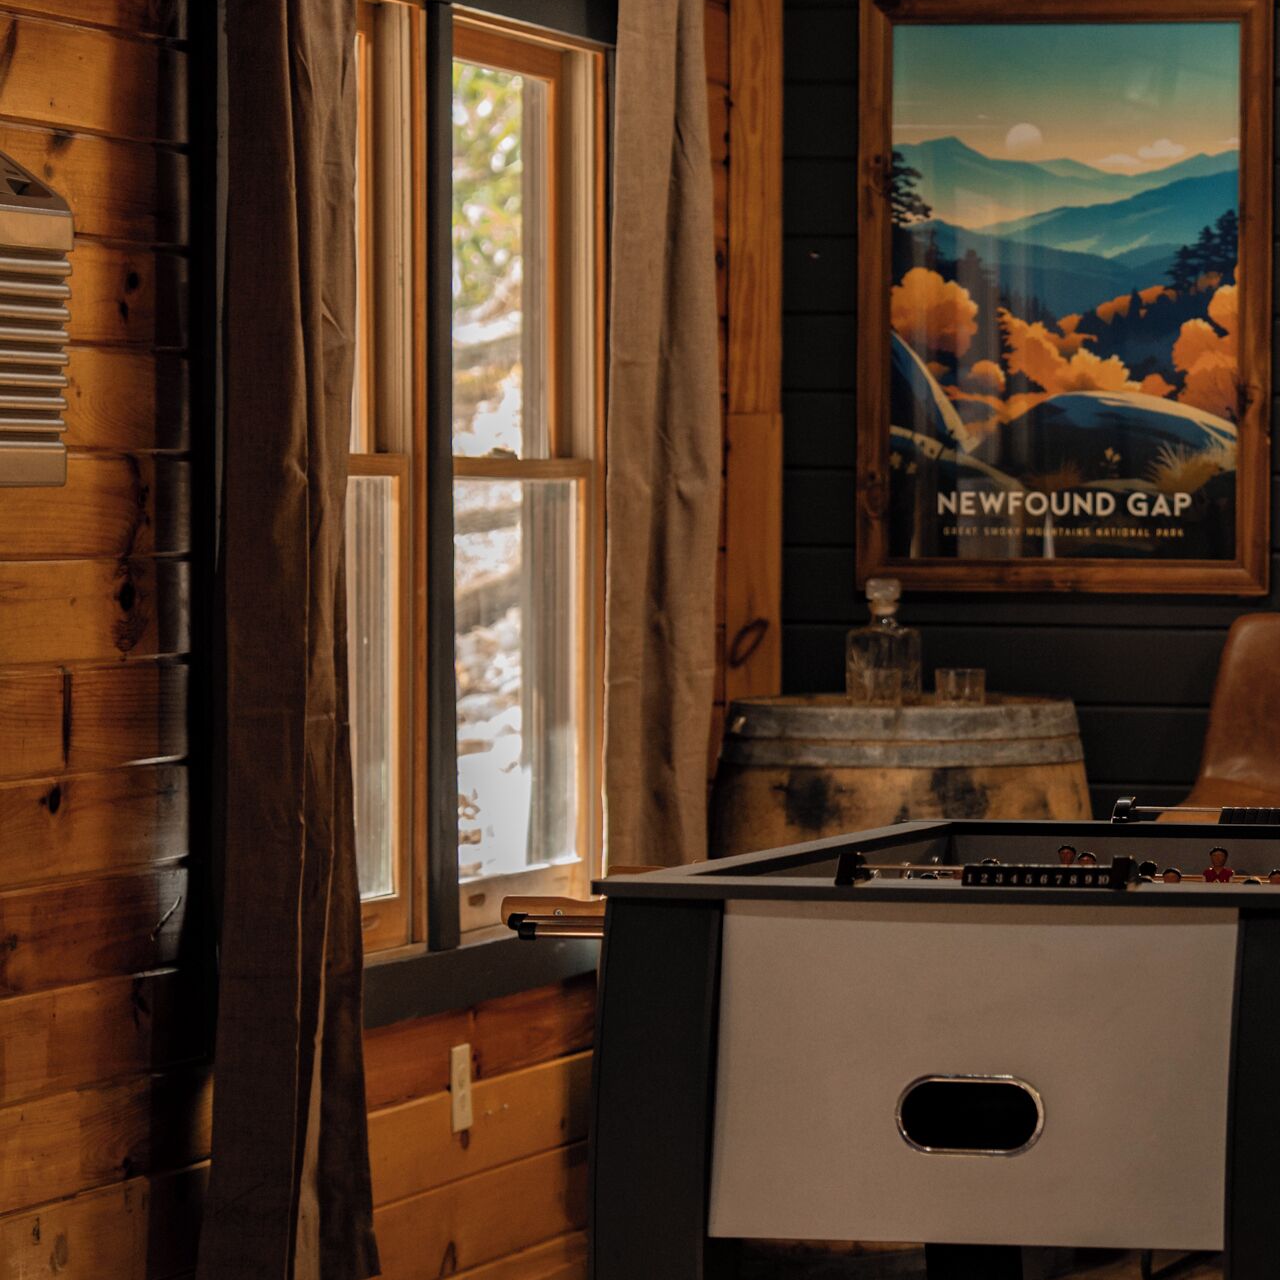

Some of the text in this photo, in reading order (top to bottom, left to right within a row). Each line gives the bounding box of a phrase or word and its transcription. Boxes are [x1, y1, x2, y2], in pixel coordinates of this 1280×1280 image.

[937, 490, 1193, 517] NEWFOUND GAP
[943, 526, 977, 537] GREAT
[1095, 527, 1150, 537] NATIONAL
[1155, 527, 1185, 537] PARK
[981, 873, 989, 884] 2
[995, 873, 1003, 884] 3
[1010, 873, 1018, 884] 4
[1025, 873, 1033, 884] 5
[1040, 873, 1049, 884] 6
[1055, 874, 1063, 885] 7
[1070, 874, 1078, 885] 8
[1085, 874, 1093, 885] 9
[1098, 874, 1110, 885] 10
